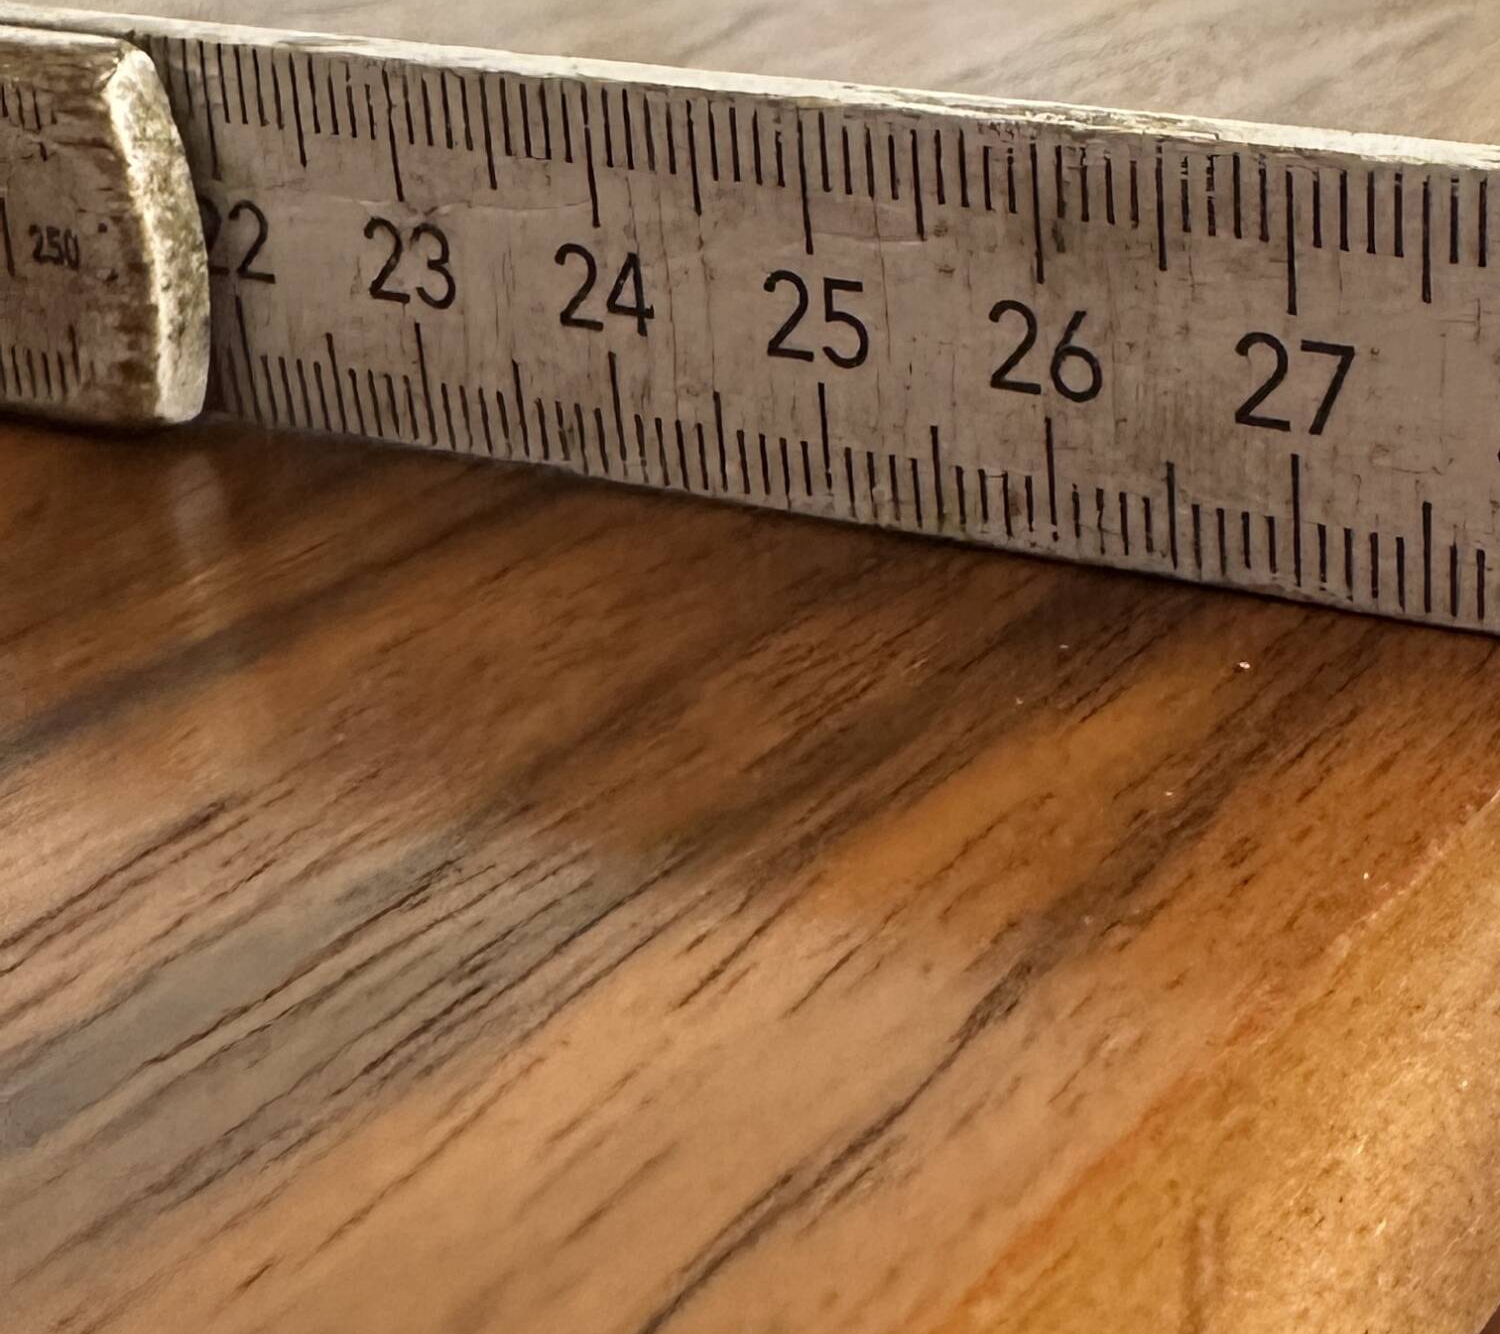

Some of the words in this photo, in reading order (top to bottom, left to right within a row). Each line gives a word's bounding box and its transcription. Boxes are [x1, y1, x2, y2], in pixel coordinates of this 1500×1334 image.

[363, 216, 457, 310] 23
[554, 242, 655, 337] 24
[763, 269, 870, 369] 25
[988, 299, 1101, 403] 26
[1234, 332, 1355, 435] 27
